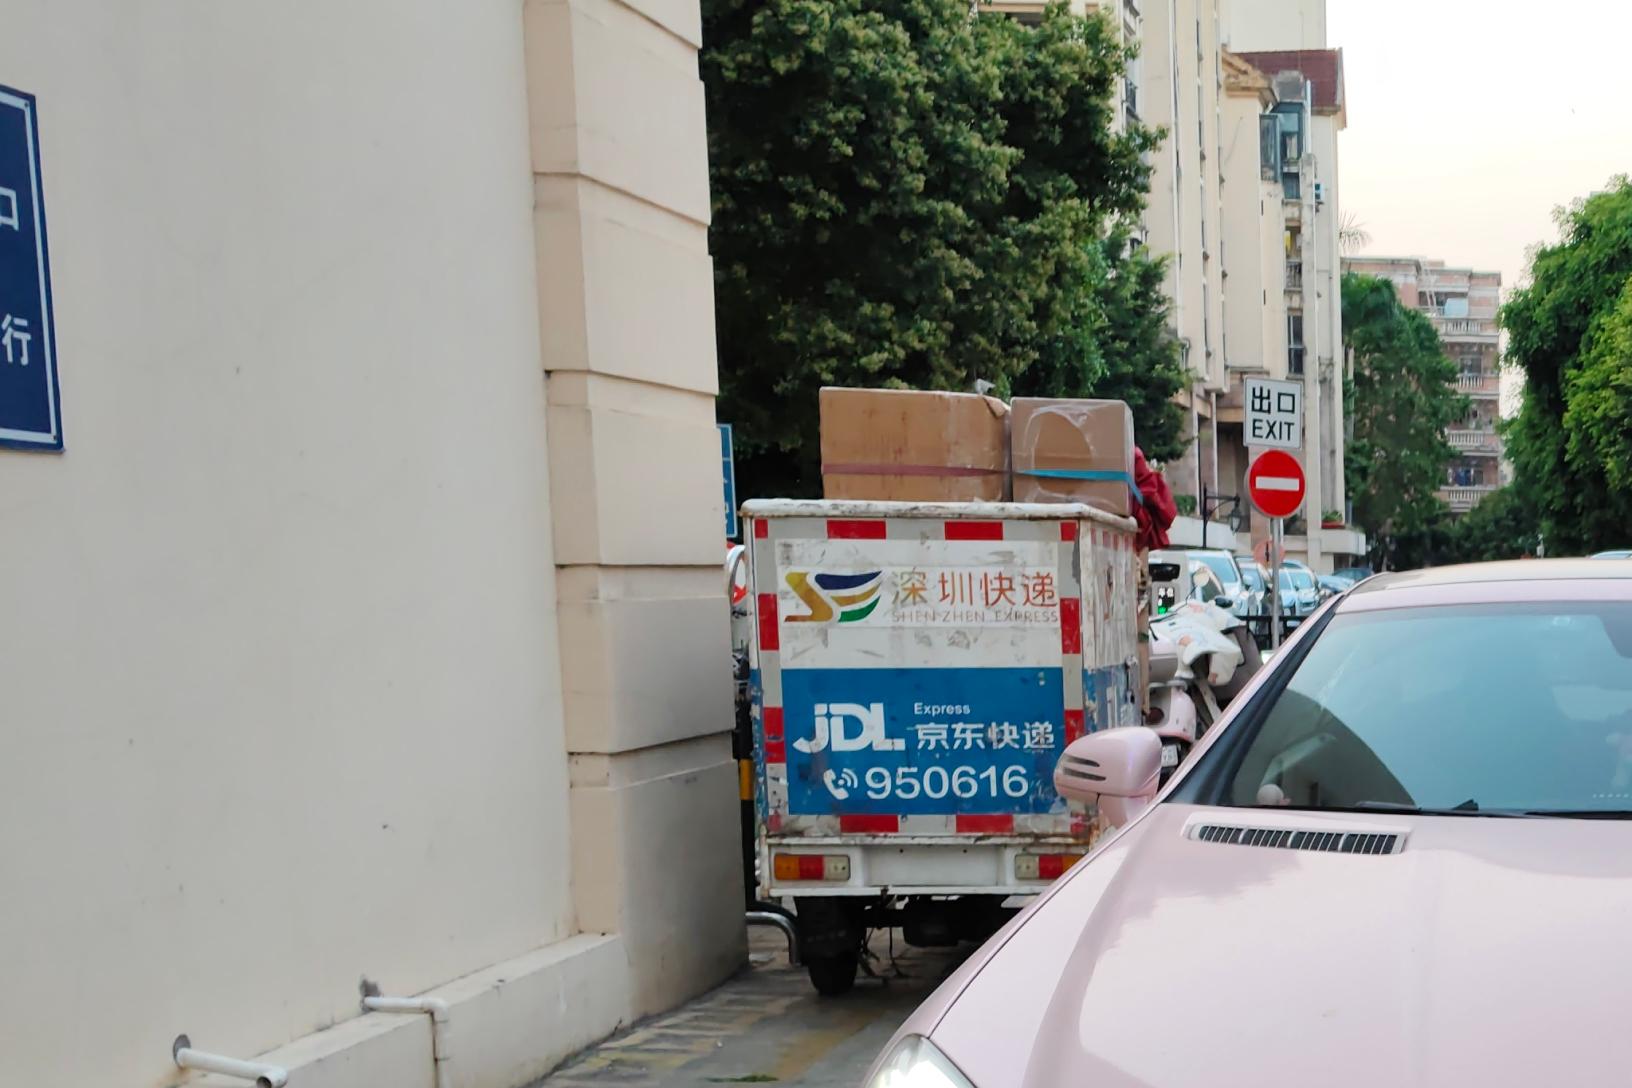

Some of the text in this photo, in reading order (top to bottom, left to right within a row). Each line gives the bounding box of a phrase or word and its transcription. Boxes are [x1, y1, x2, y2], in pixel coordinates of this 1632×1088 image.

[1251, 386, 1296, 415] 出口
[1252, 418, 1295, 441] EXIT
[891, 567, 1059, 608] 深圳快递
[941, 609, 986, 623] ZHEN
[994, 609, 1059, 623] EXPRESS
[792, 702, 971, 754] JDL Express
[916, 720, 1056, 750] 京东快递
[864, 764, 1030, 801] 950616
